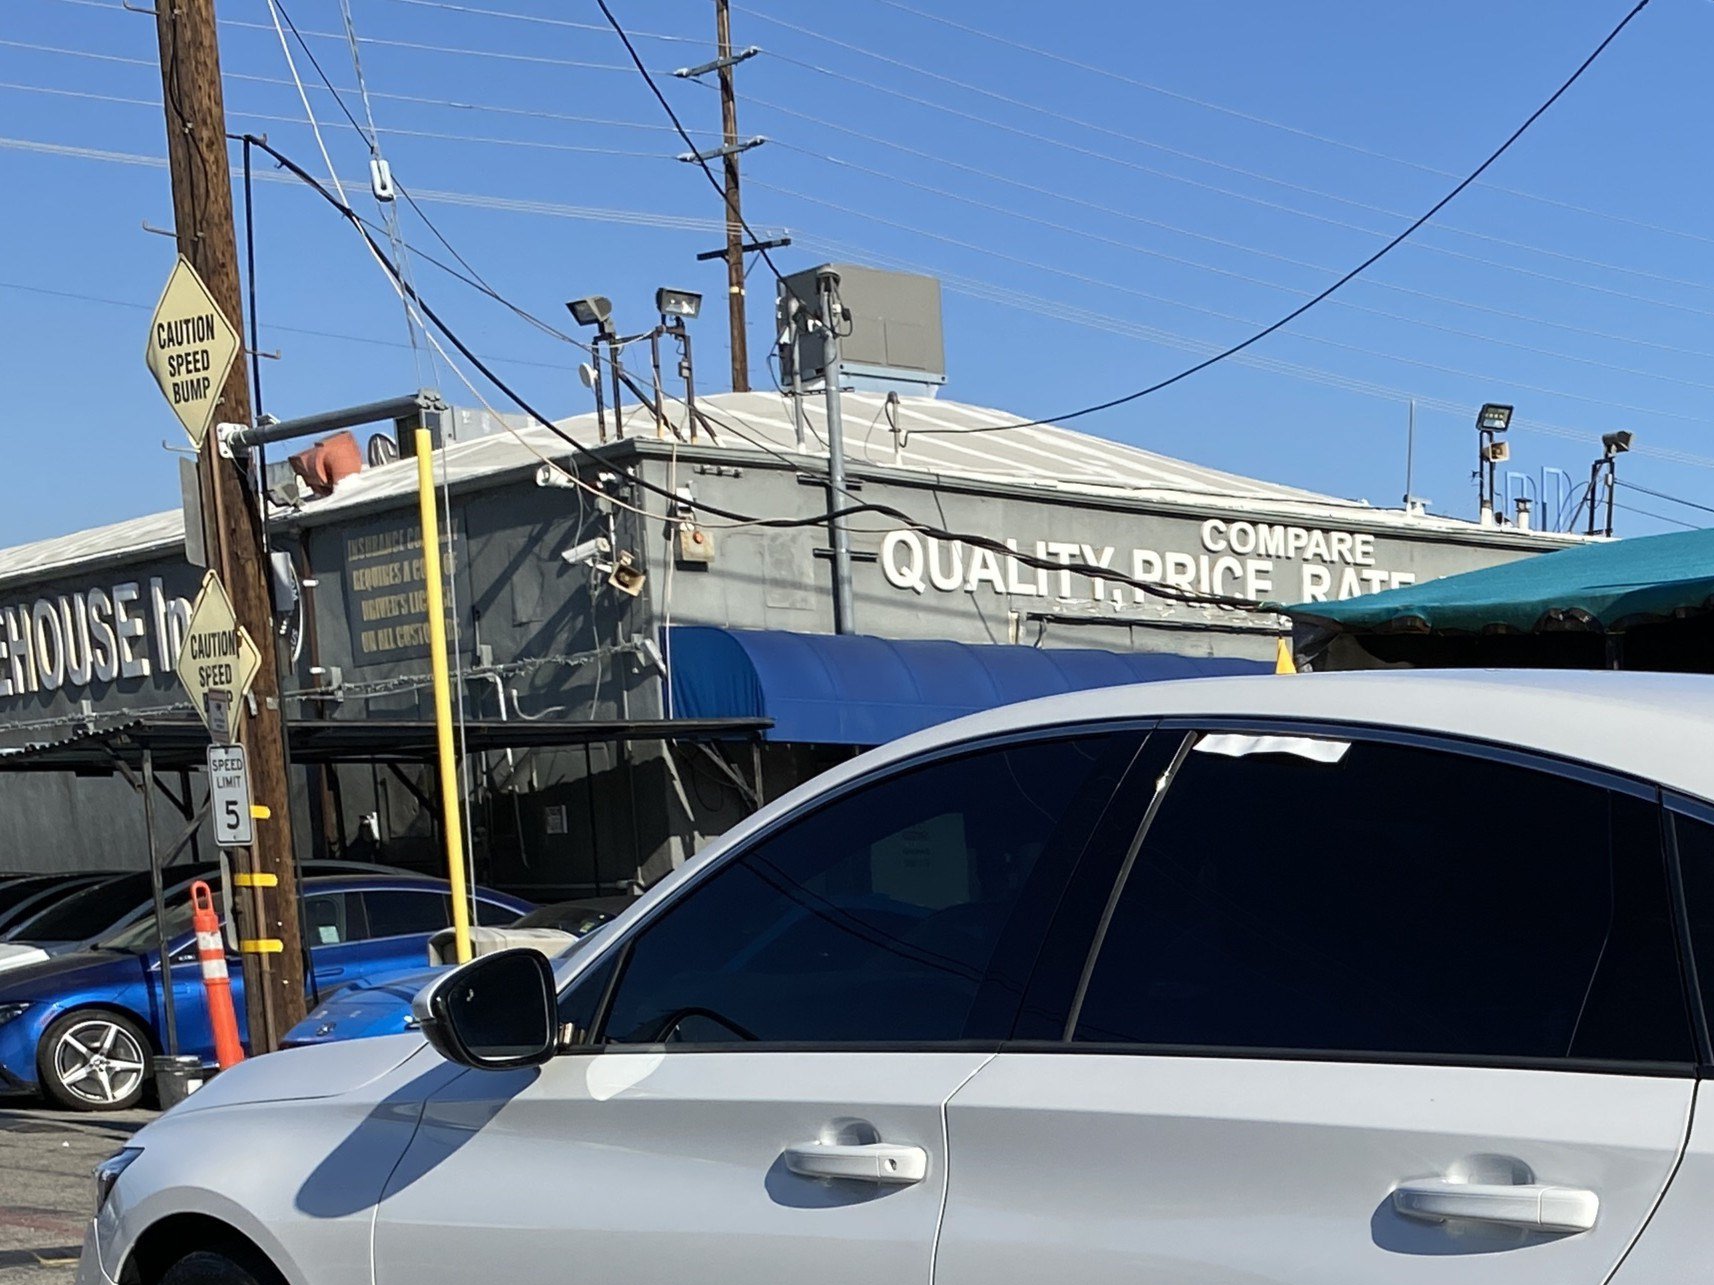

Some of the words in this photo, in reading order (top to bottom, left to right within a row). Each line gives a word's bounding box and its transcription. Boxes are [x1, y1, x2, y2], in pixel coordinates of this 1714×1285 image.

[157, 313, 215, 350] CAUTION
[168, 349, 210, 377] SPEED
[172, 377, 210, 404] BUMP
[1201, 518, 1376, 566] COMPARE
[1132, 549, 1274, 611] PRICE
[190, 629, 240, 660] CAUTION
[199, 662, 232, 688] SPEED
[203, 689, 234, 713] BP
[212, 758, 243, 772] SPEED
[216, 775, 242, 789] LIMIT
[225, 800, 240, 830] 5
